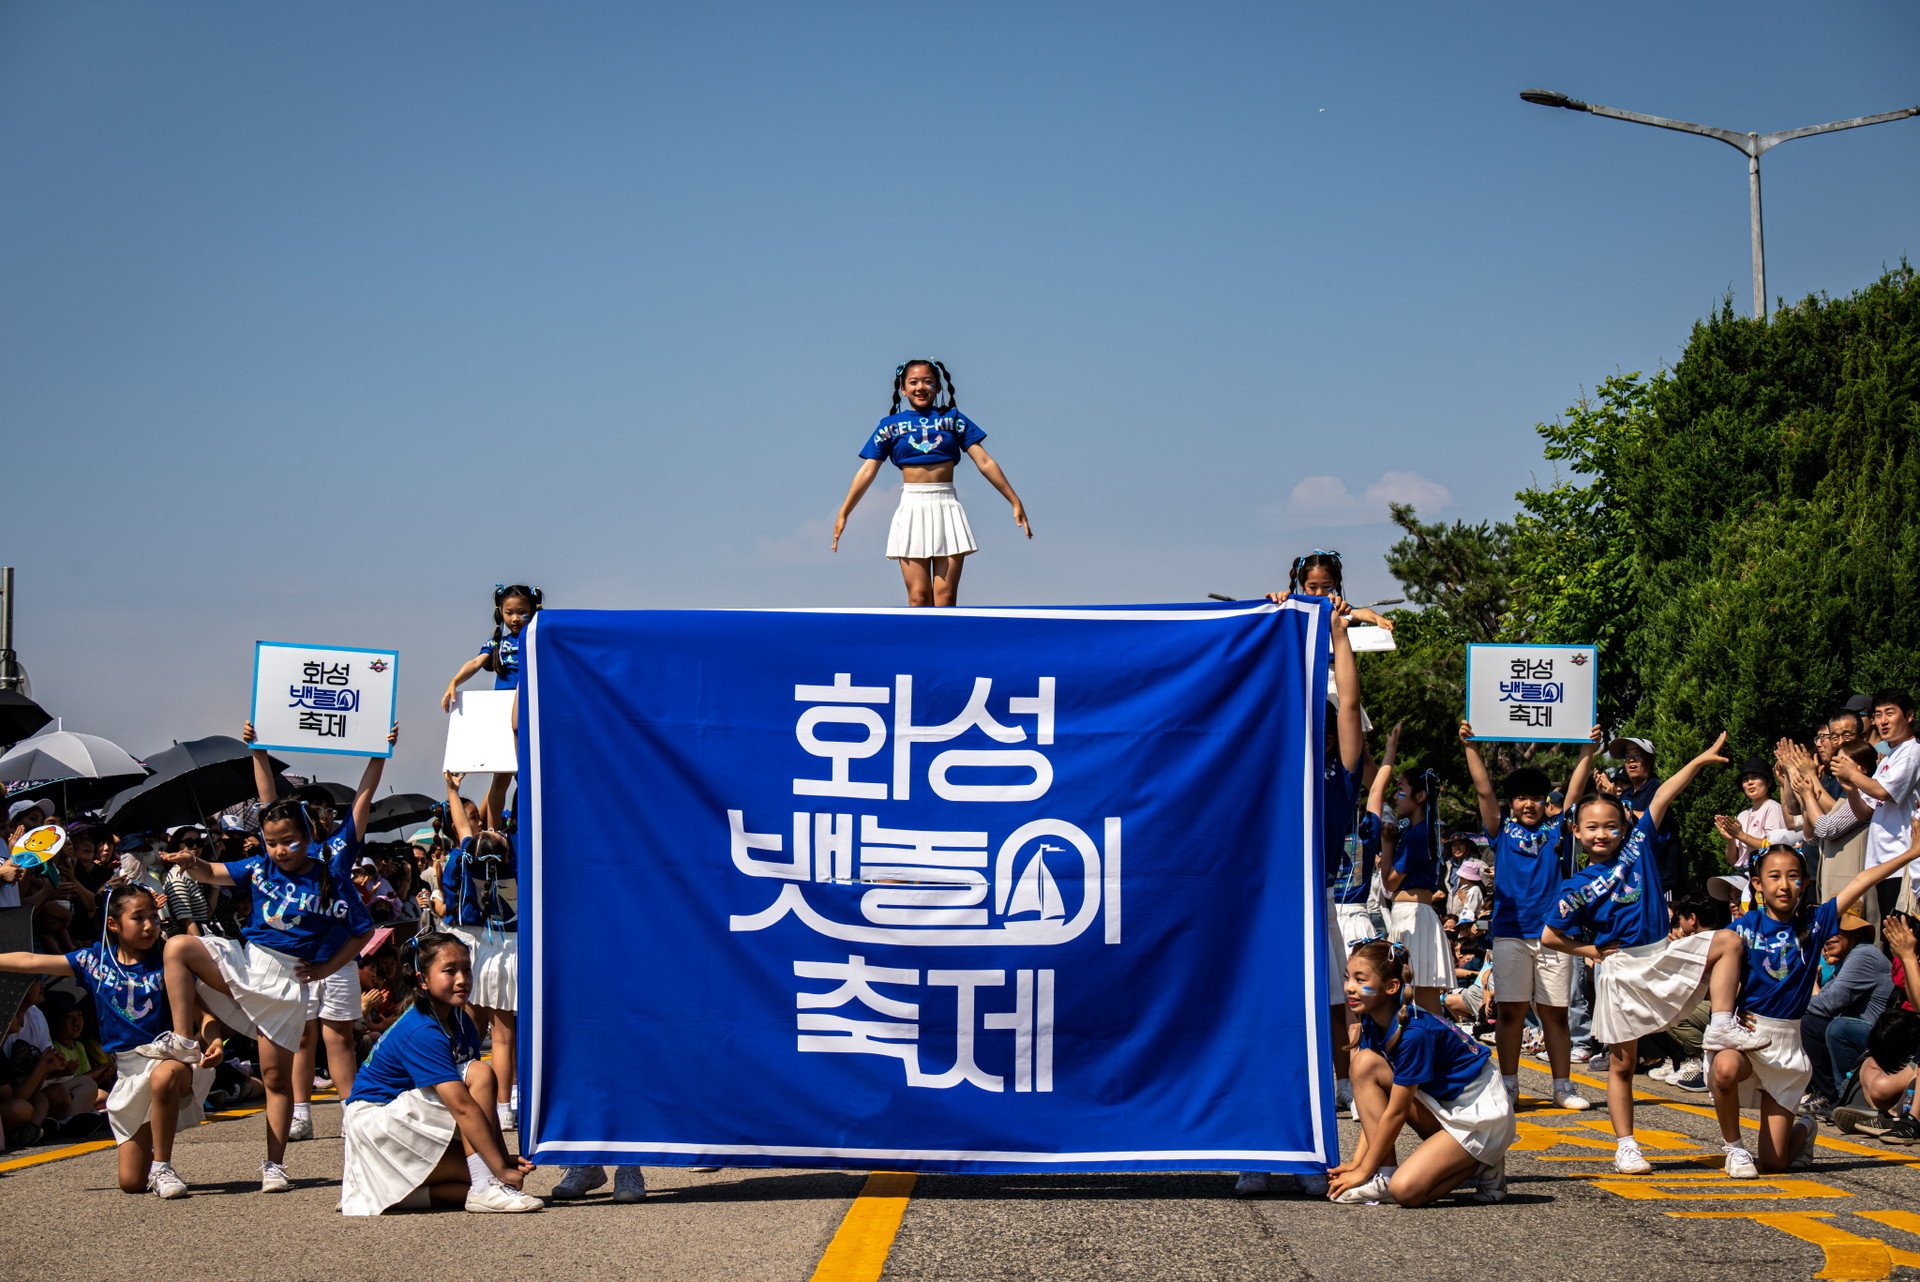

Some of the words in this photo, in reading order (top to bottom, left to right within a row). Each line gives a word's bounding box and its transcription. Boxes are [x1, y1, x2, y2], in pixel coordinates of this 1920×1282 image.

[874, 421, 917, 447] ANGEL
[302, 661, 350, 686] 화성
[1510, 658, 1553, 680] 화성
[288, 685, 360, 712] 뱃놀이
[1499, 681, 1563, 703] 뱃놀이
[299, 711, 347, 738] 축제
[1509, 704, 1552, 727] 축제
[792, 672, 1056, 802] 화성
[727, 809, 1122, 946] 뱃놀이
[1558, 875, 1616, 918] ANGEL
[75, 949, 123, 991] ANGEL
[793, 954, 1055, 1093] 축제
